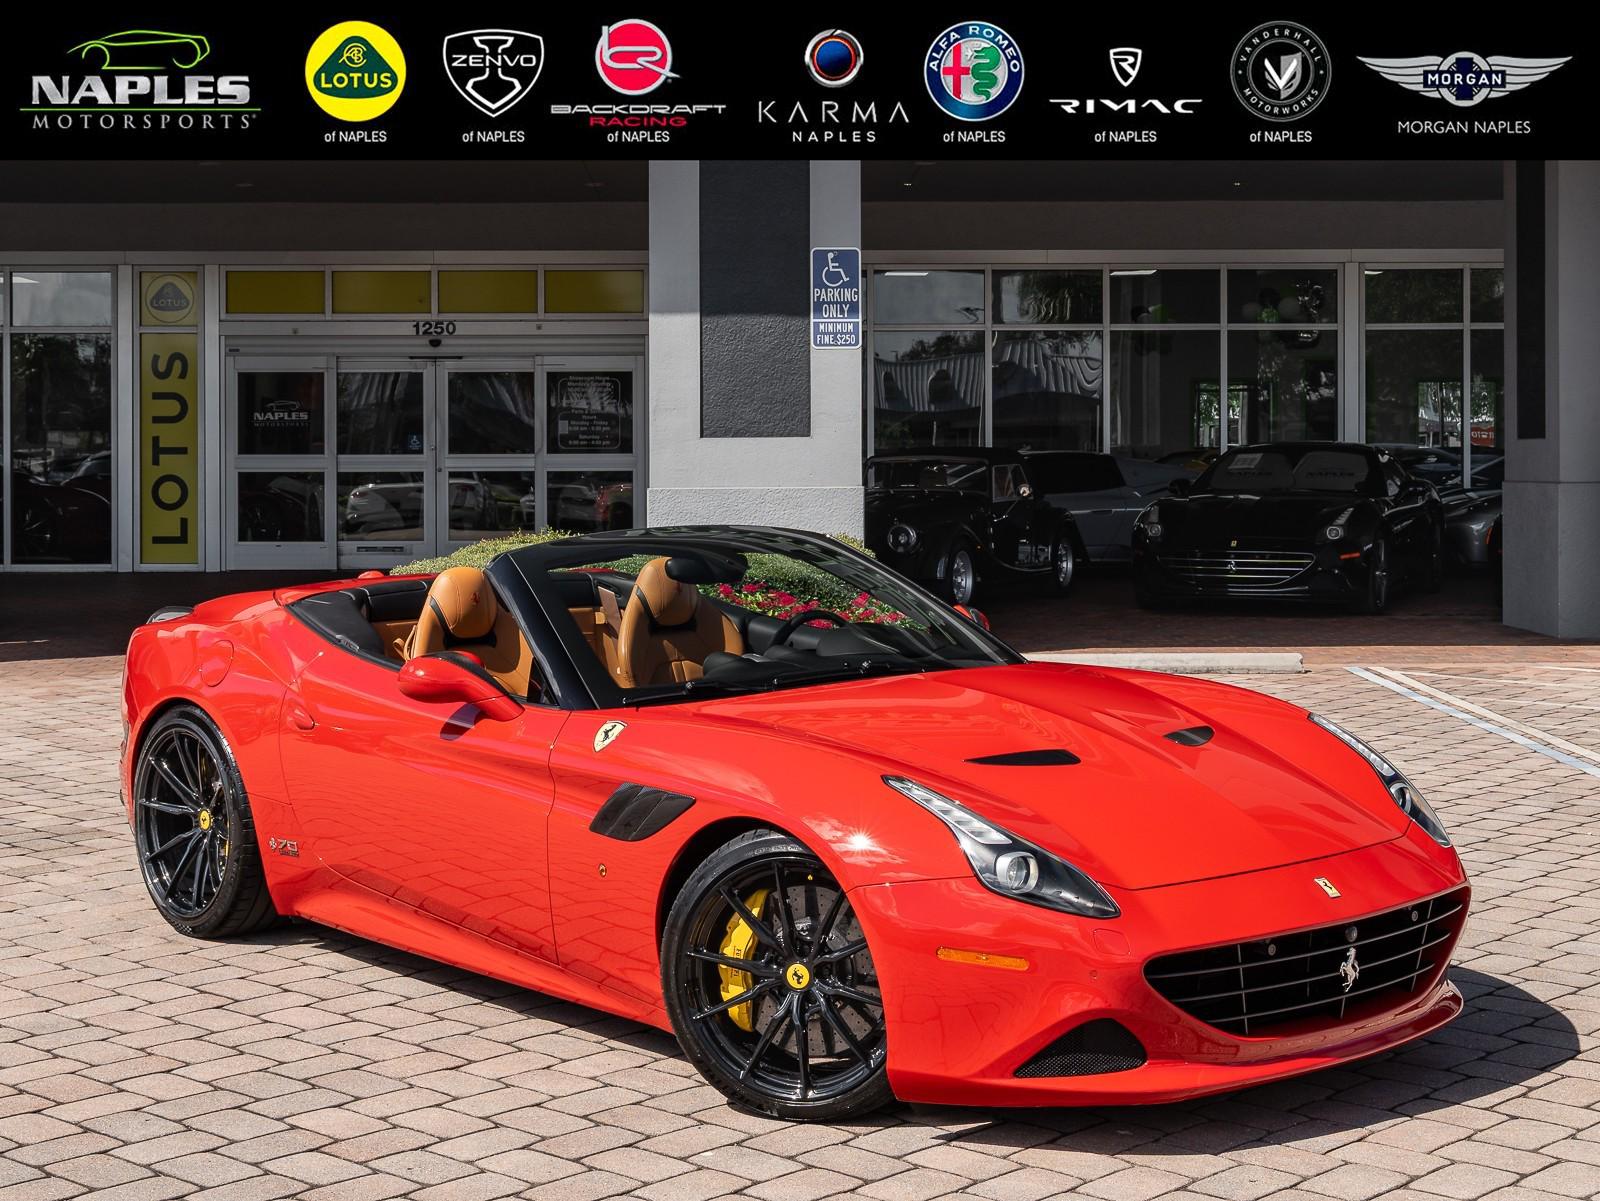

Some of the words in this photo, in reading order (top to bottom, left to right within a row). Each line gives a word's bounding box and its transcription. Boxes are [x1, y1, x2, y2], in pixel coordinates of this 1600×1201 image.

[814, 288, 858, 302] PARKING
[153, 299, 188, 307] LOTUS
[822, 303, 850, 318] ONLY
[412, 321, 457, 336] 1250
[819, 322, 854, 333] MINIMUM
[816, 334, 835, 345] FINE
[836, 334, 856, 346] $250
[253, 411, 309, 421] NAPLES
[151, 352, 189, 545] LOTUS
